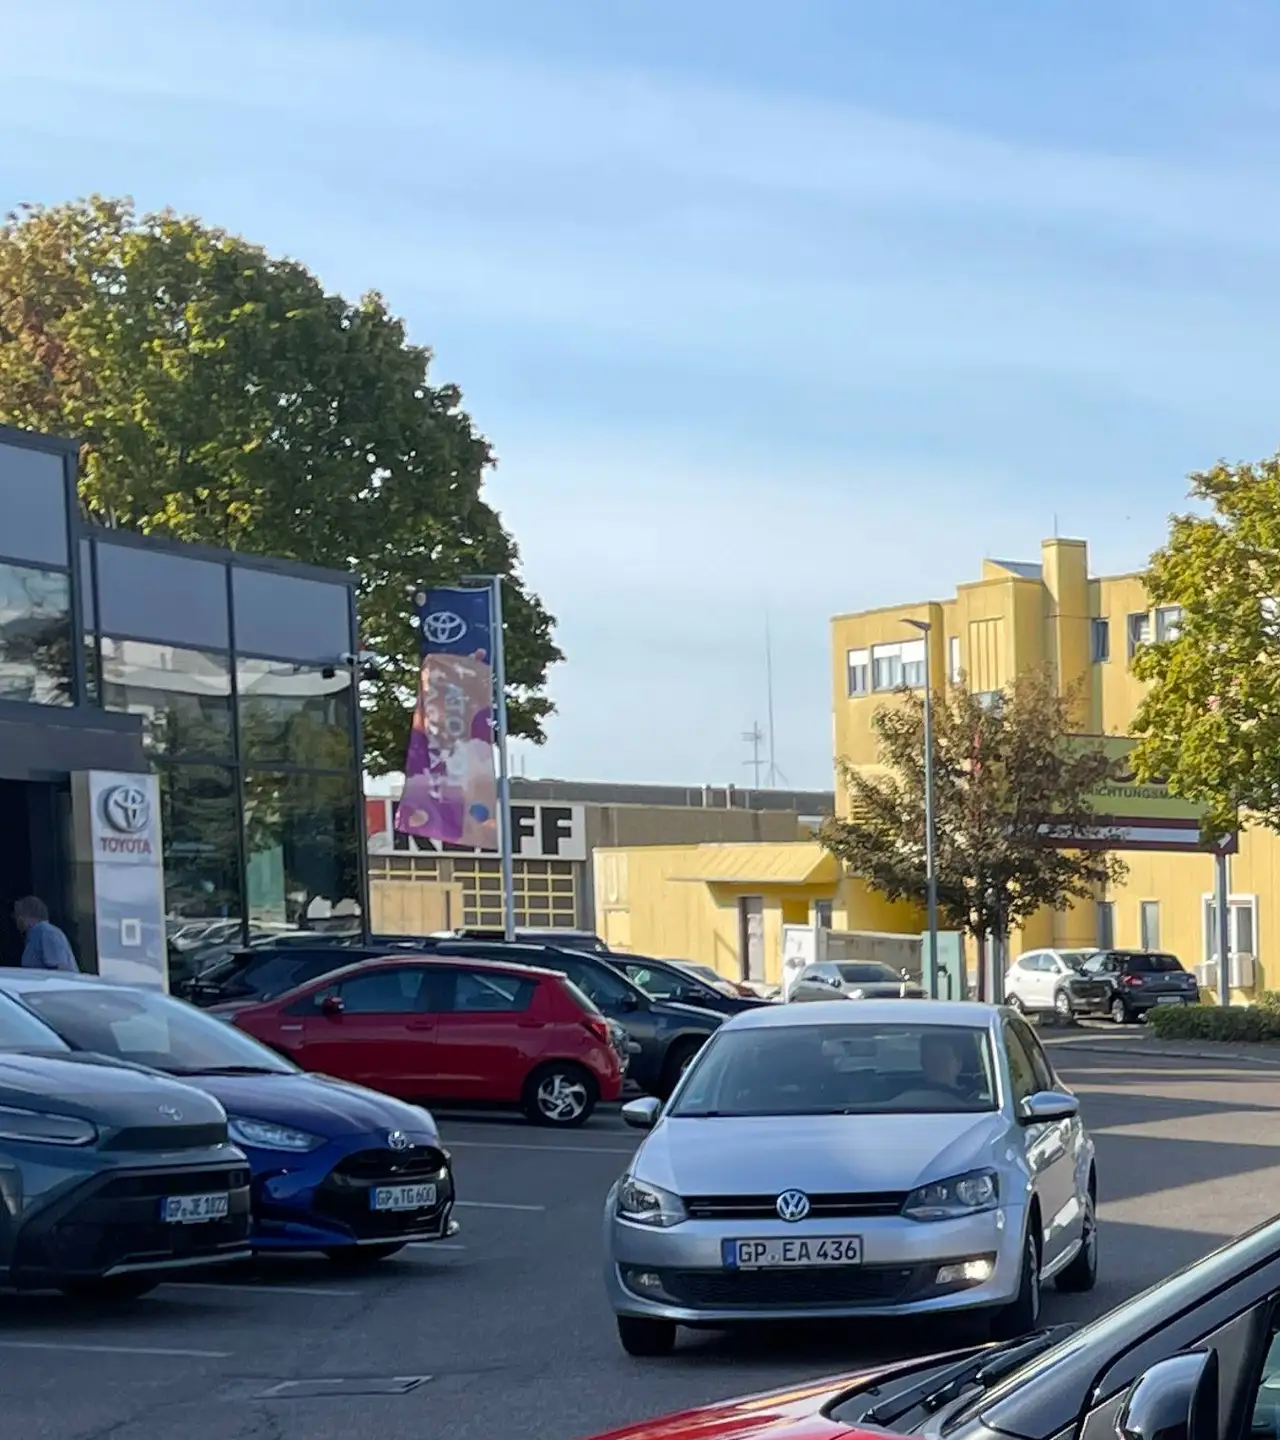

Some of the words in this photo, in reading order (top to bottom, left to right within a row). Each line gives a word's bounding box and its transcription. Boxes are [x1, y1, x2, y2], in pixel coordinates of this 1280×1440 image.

[100, 837, 152, 853] TOYOTA
[739, 1242, 767, 1263] GP
[783, 1241, 811, 1262] EA
[816, 1239, 857, 1261] 436
